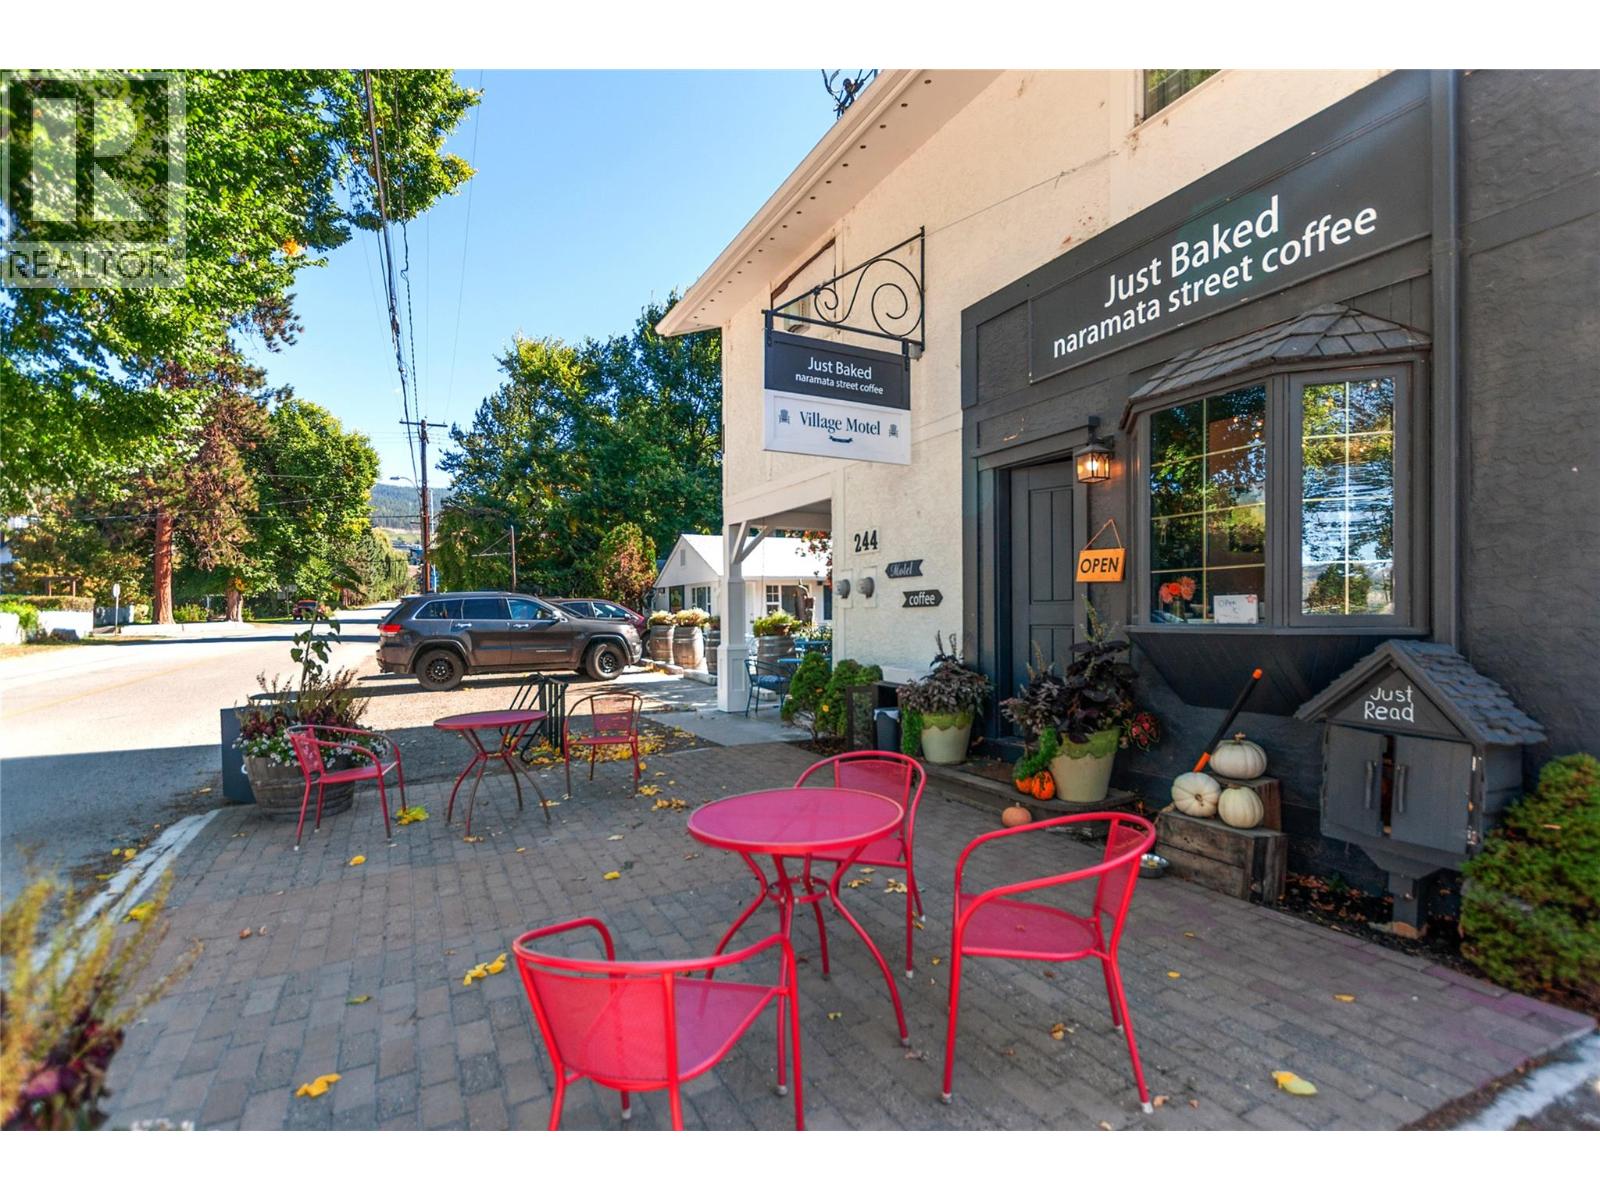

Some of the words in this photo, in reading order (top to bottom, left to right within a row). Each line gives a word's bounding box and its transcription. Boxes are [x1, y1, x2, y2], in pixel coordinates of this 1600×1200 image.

[1104, 257, 1162, 307] Just
[1170, 194, 1279, 279] Baked
[1053, 298, 1160, 358] naramata
[1168, 255, 1253, 313] street
[1261, 207, 1377, 274] coffee
[807, 356, 833, 374] Just
[835, 361, 872, 380] Baked
[795, 373, 835, 387] naramata
[836, 380, 859, 391] street
[860, 383, 884, 395] coffee
[800, 411, 842, 433] Village
[846, 417, 881, 435] Motel
[854, 530, 878, 553] 244
[1080, 557, 1119, 574] OPEN
[908, 591, 936, 606] coffee
[1369, 685, 1414, 703] Just
[1364, 700, 1415, 723] Read
